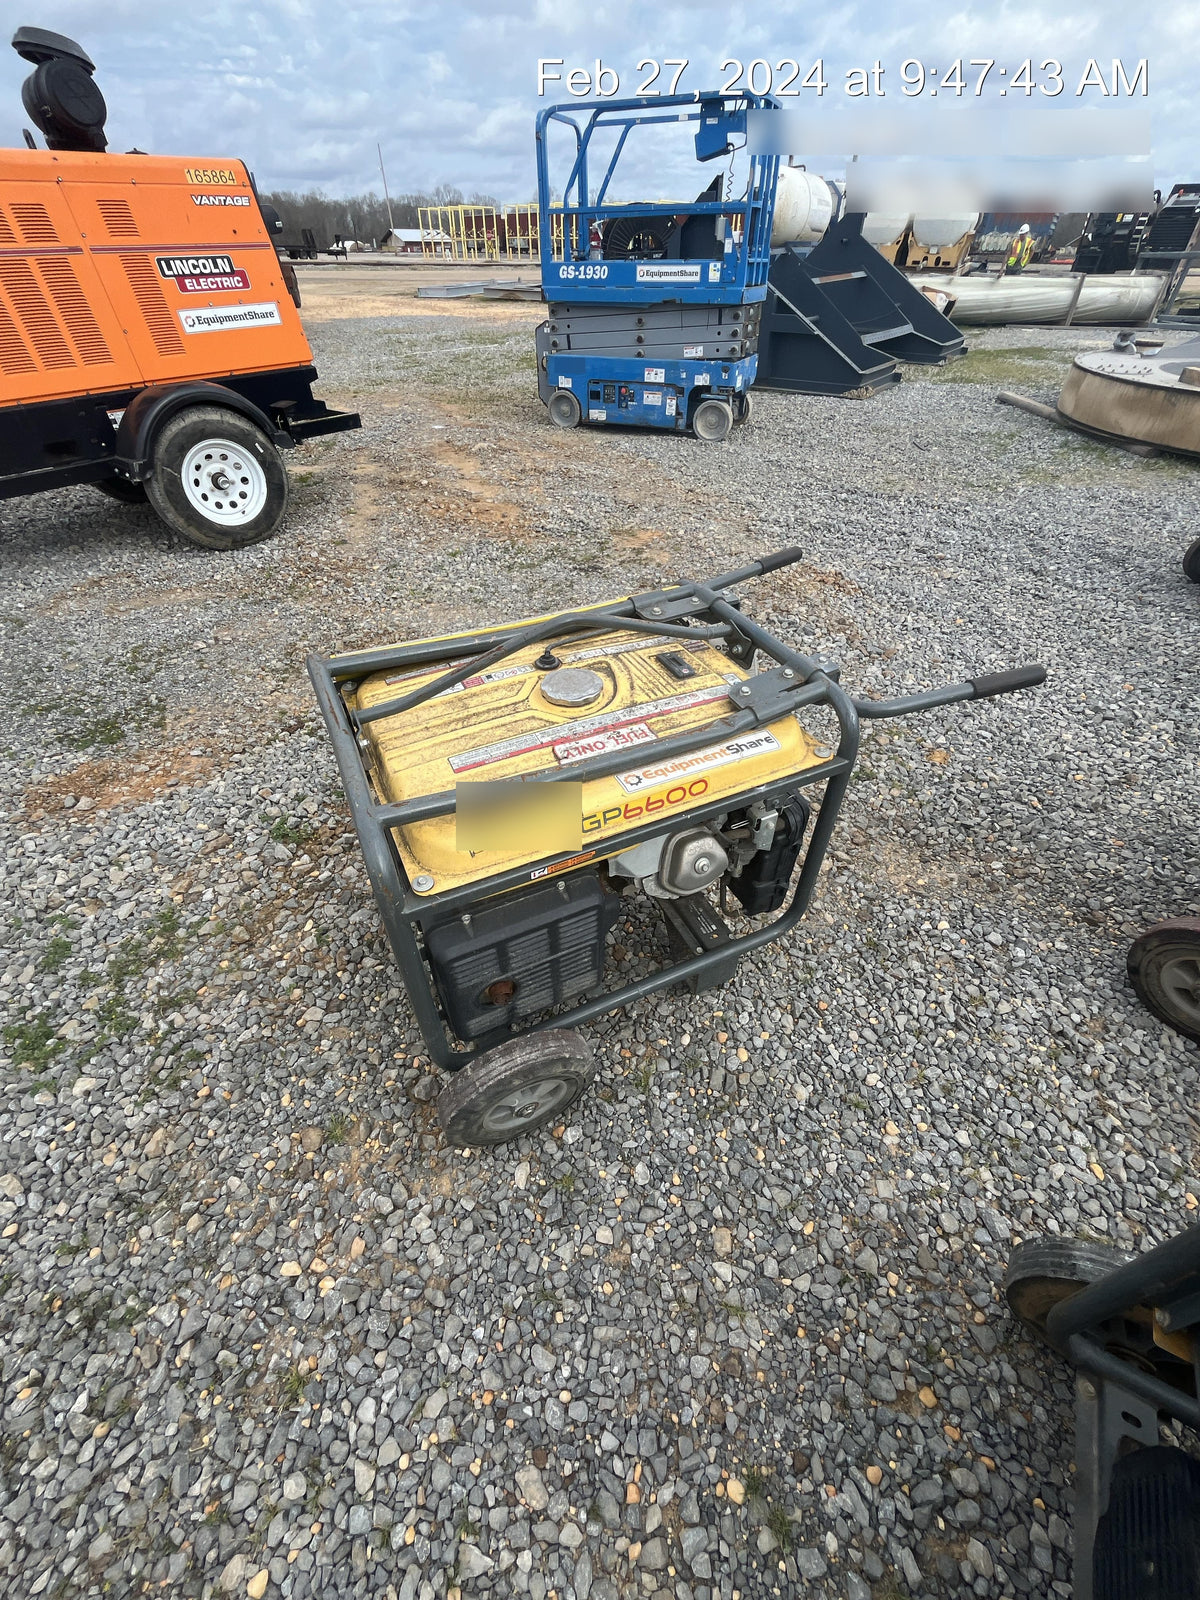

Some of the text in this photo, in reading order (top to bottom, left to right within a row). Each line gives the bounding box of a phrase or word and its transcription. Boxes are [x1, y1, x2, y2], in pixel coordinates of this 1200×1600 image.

[186, 169, 236, 184] 165864
[191, 195, 250, 205] VANTAGE
[160, 258, 231, 275] LINCOLN
[559, 265, 608, 279] GS-1930
[645, 269, 699, 279] EquipmentShare
[185, 276, 244, 290] ELECTRIC
[197, 310, 275, 327] EquipmentShare
[607, 729, 649, 746] FUEL
[564, 740, 606, 759] ONLY
[641, 735, 775, 780] EquipmentShare
[581, 778, 709, 834] GP6600
